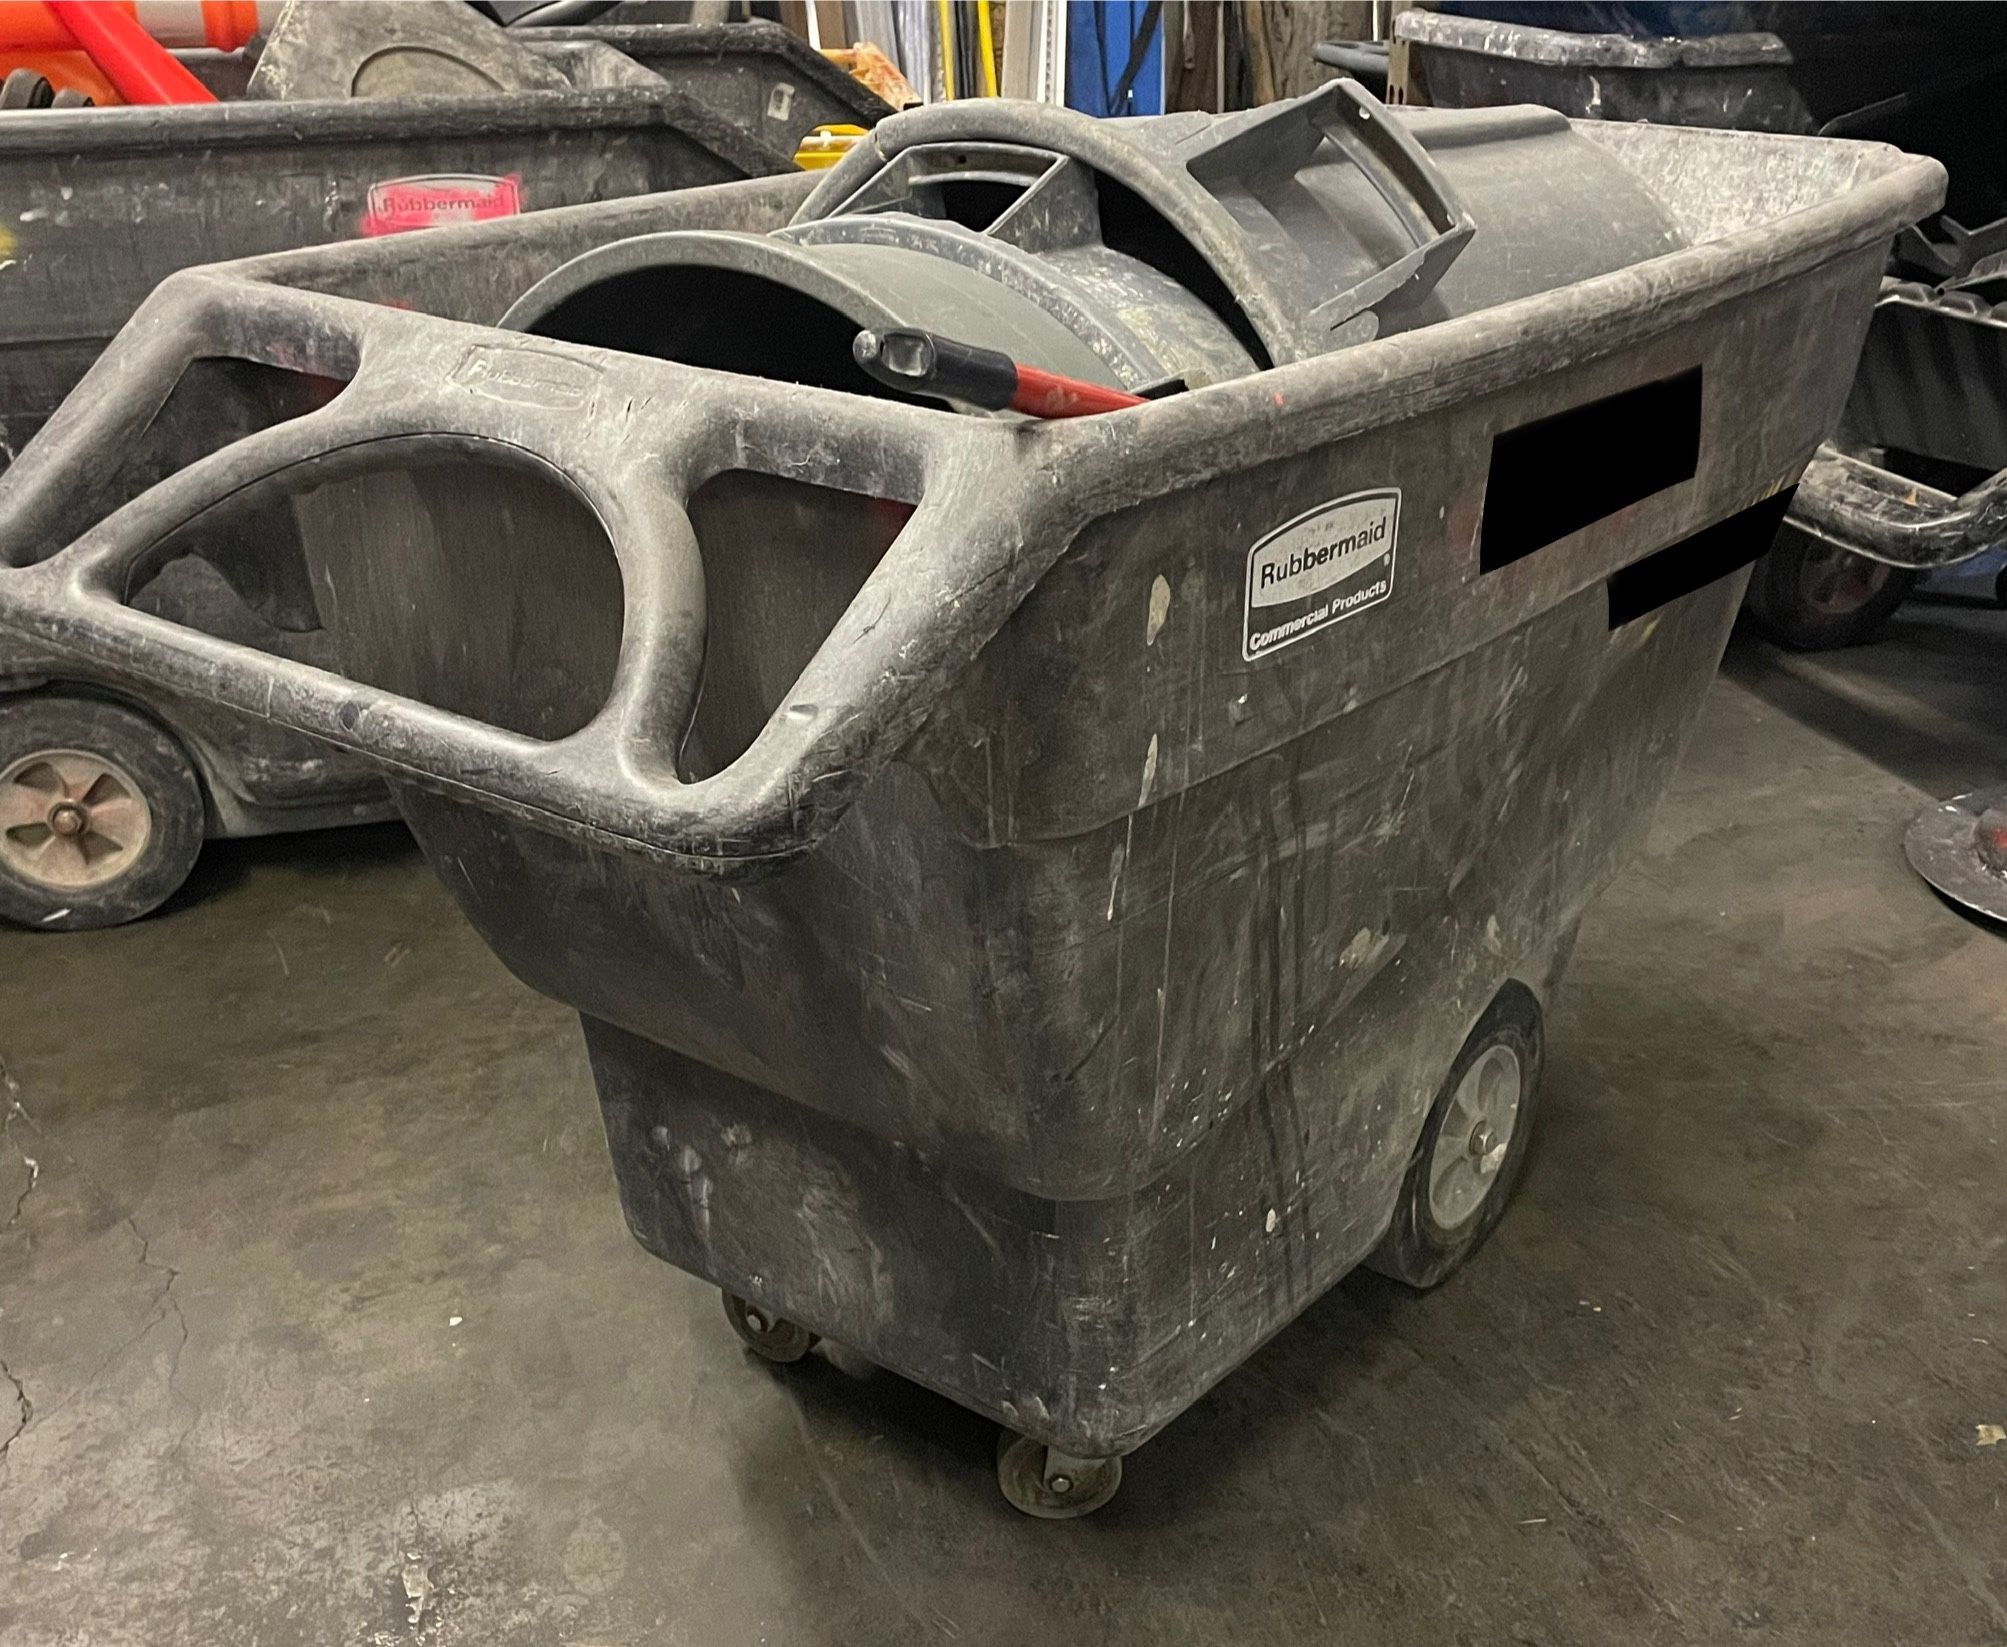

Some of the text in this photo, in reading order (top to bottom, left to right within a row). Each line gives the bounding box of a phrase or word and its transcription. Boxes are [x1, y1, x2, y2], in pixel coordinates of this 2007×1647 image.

[382, 193, 504, 214] Rubbermaid
[1260, 516, 1387, 589] Rubbermaid
[1250, 579, 1387, 651] Commercial Products
